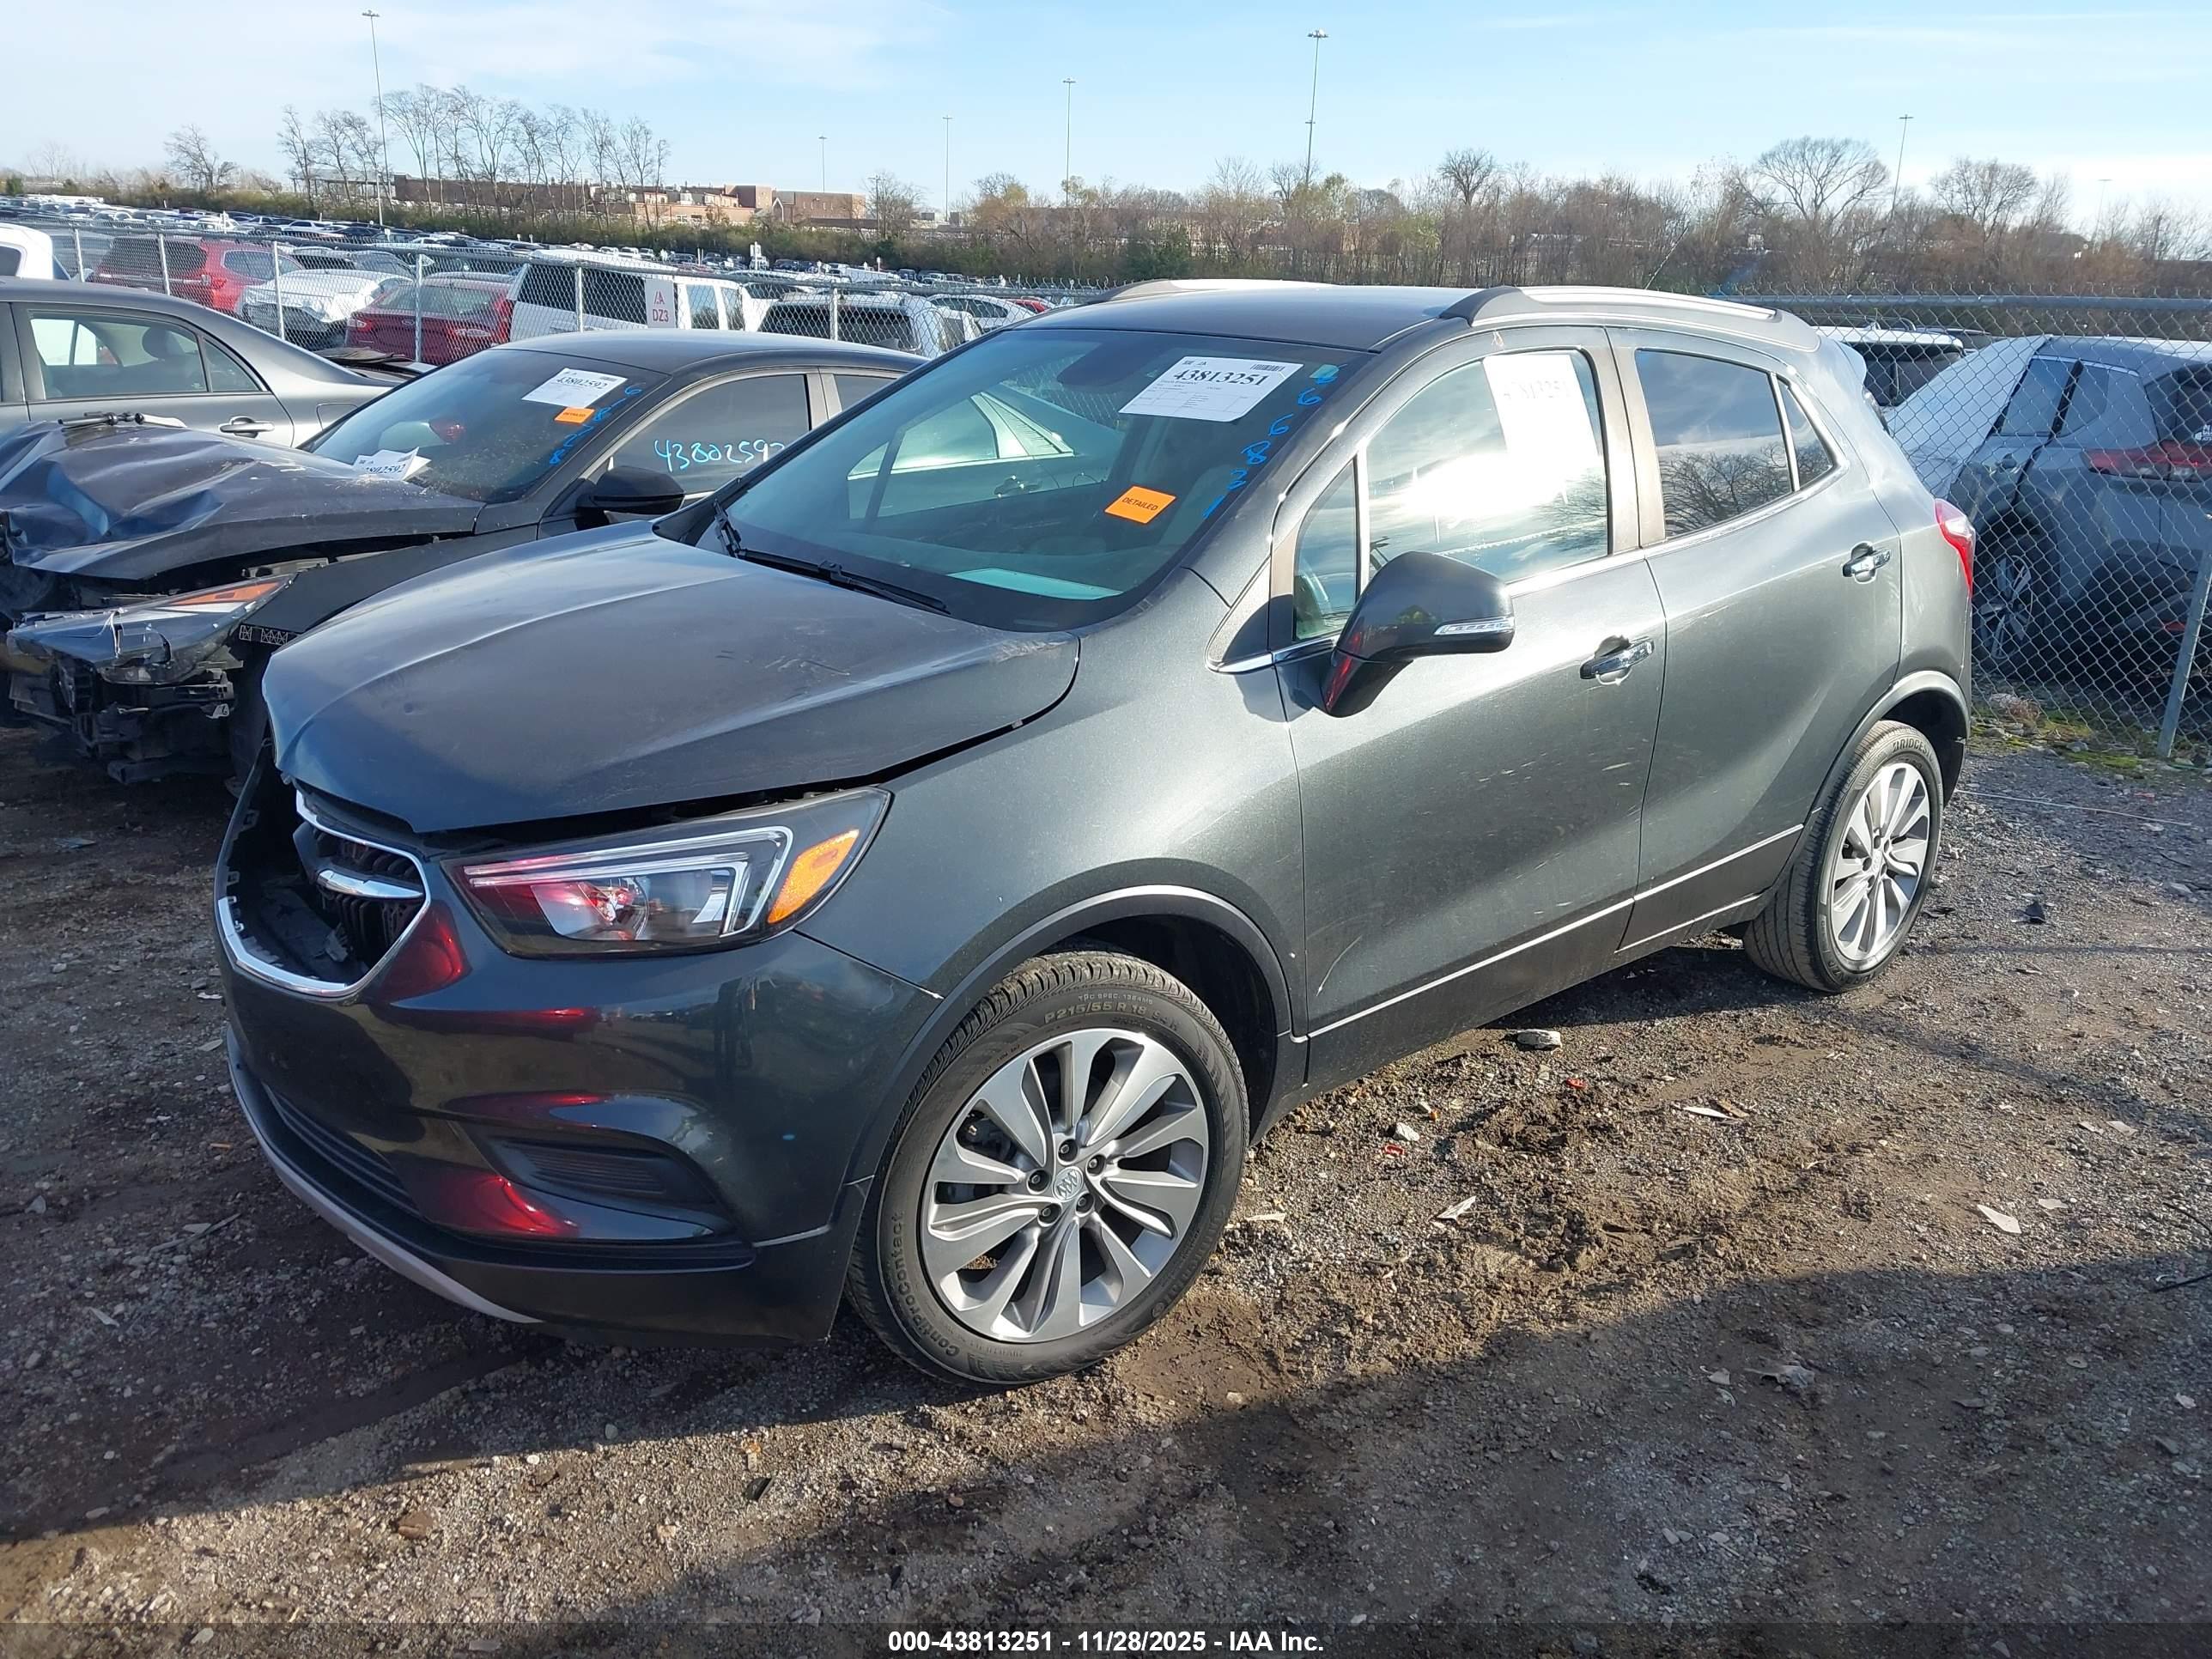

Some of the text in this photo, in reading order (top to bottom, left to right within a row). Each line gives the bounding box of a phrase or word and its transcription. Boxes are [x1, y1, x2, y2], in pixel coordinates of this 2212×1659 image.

[653, 308, 669, 322] DZ3
[556, 377, 609, 390] 43802592
[1174, 369, 1270, 386] 43813251
[1121, 497, 1159, 511] DETAILED
[1044, 1001, 1113, 1024] P215/55
